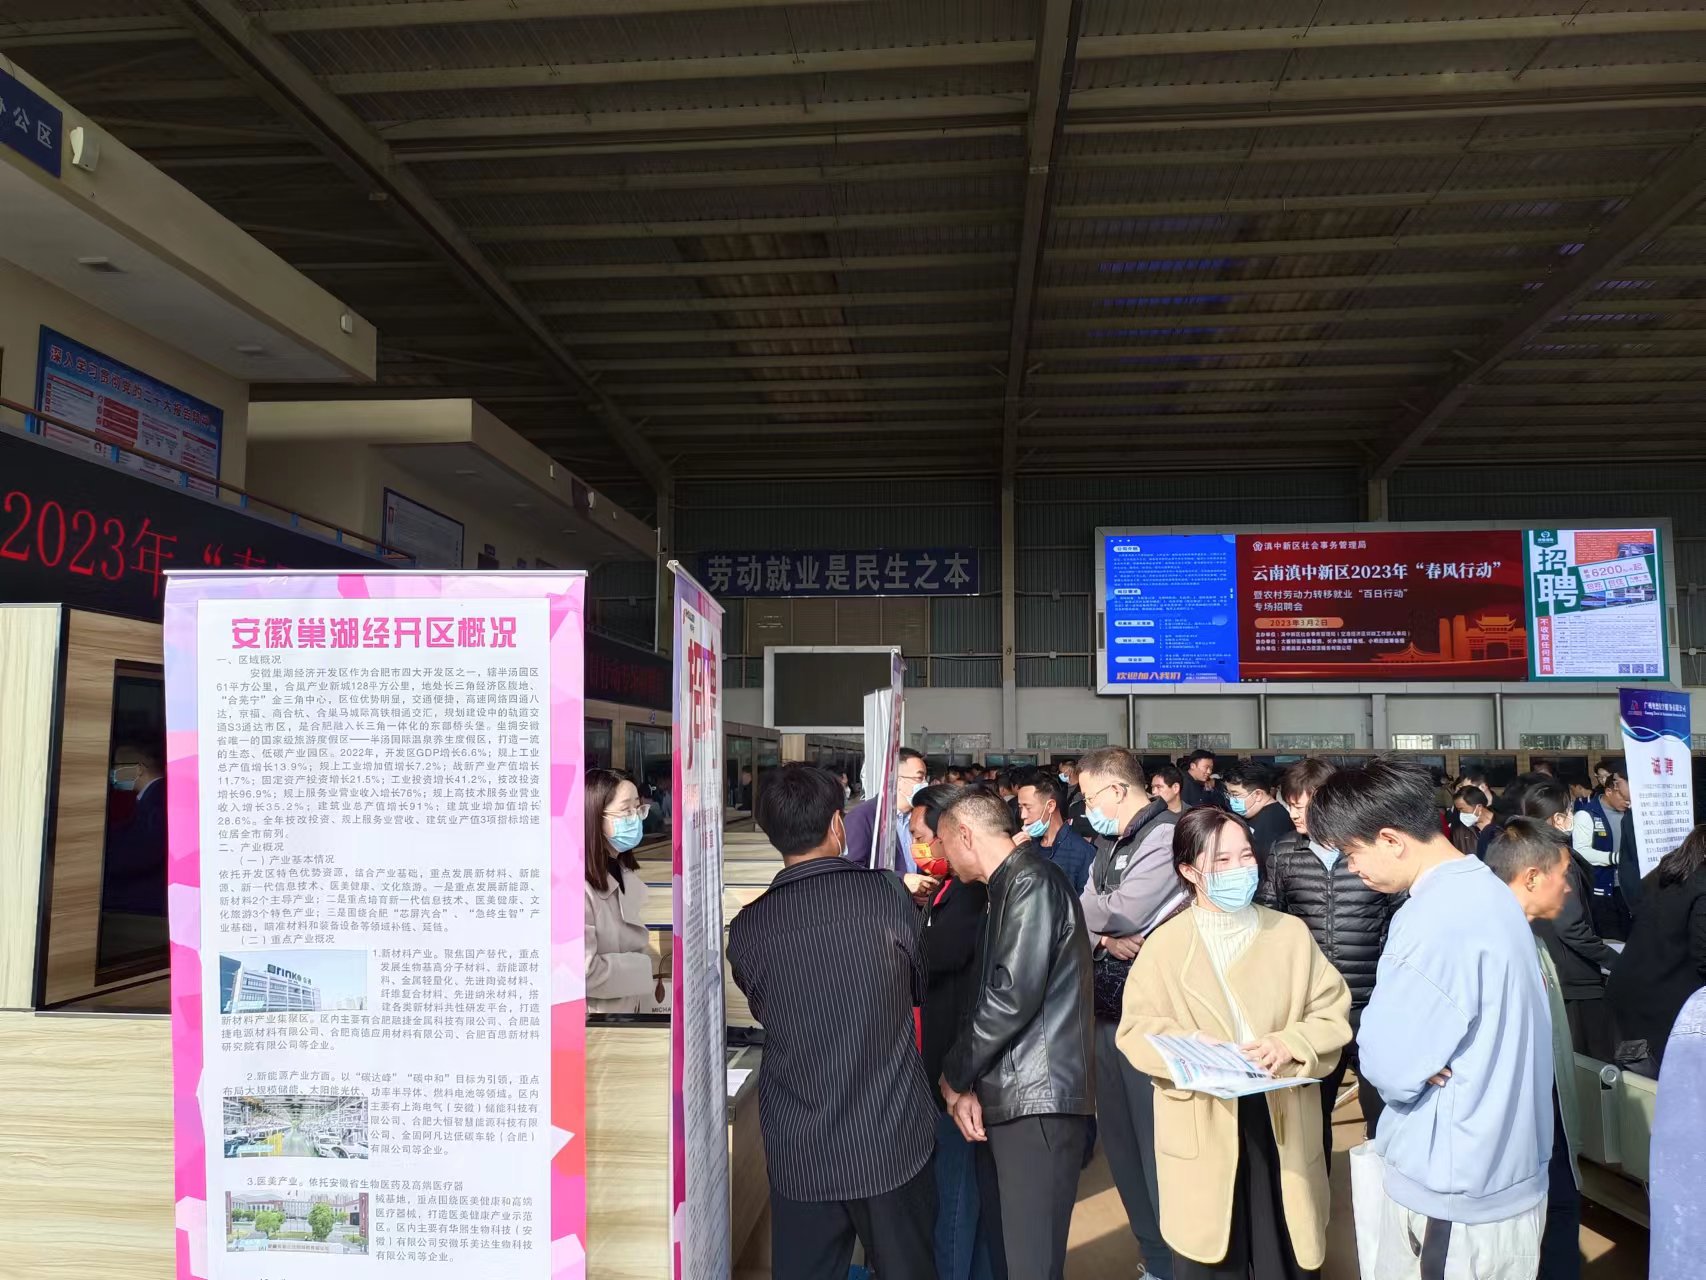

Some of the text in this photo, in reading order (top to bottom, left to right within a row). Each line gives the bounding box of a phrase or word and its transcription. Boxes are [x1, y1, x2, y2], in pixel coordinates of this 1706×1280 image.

[1264, 541, 1367, 550] 滇中新区社会事务管理局
[707, 553, 970, 592] 劳动就业是民生之本
[1252, 562, 1501, 582] 云南滇中新区2023年“春风行动”
[1537, 549, 1578, 616] 招聘
[1254, 589, 1408, 600] 暨农村劳动力转移就业“百日行动”
[1254, 602, 1303, 612] 专场招聘会
[1270, 619, 1328, 627] 2023年3月2日
[232, 617, 517, 648] 安徽巢湖经开区概况
[217, 655, 282, 665] 一、区域概况
[1116, 672, 1181, 680] 欢迎加入我们
[218, 828, 289, 839] 位居全市前列。
[218, 842, 284, 852] 二、产业概况
[240, 854, 335, 866] （一）产业基本情况
[241, 934, 335, 945] （二）重点产业概况
[221, 1040, 335, 1051] 研究院有限公司等企业。
[370, 1144, 449, 1155] 有限公司等企业。
[375, 1250, 455, 1263] 有限公司等企业。
